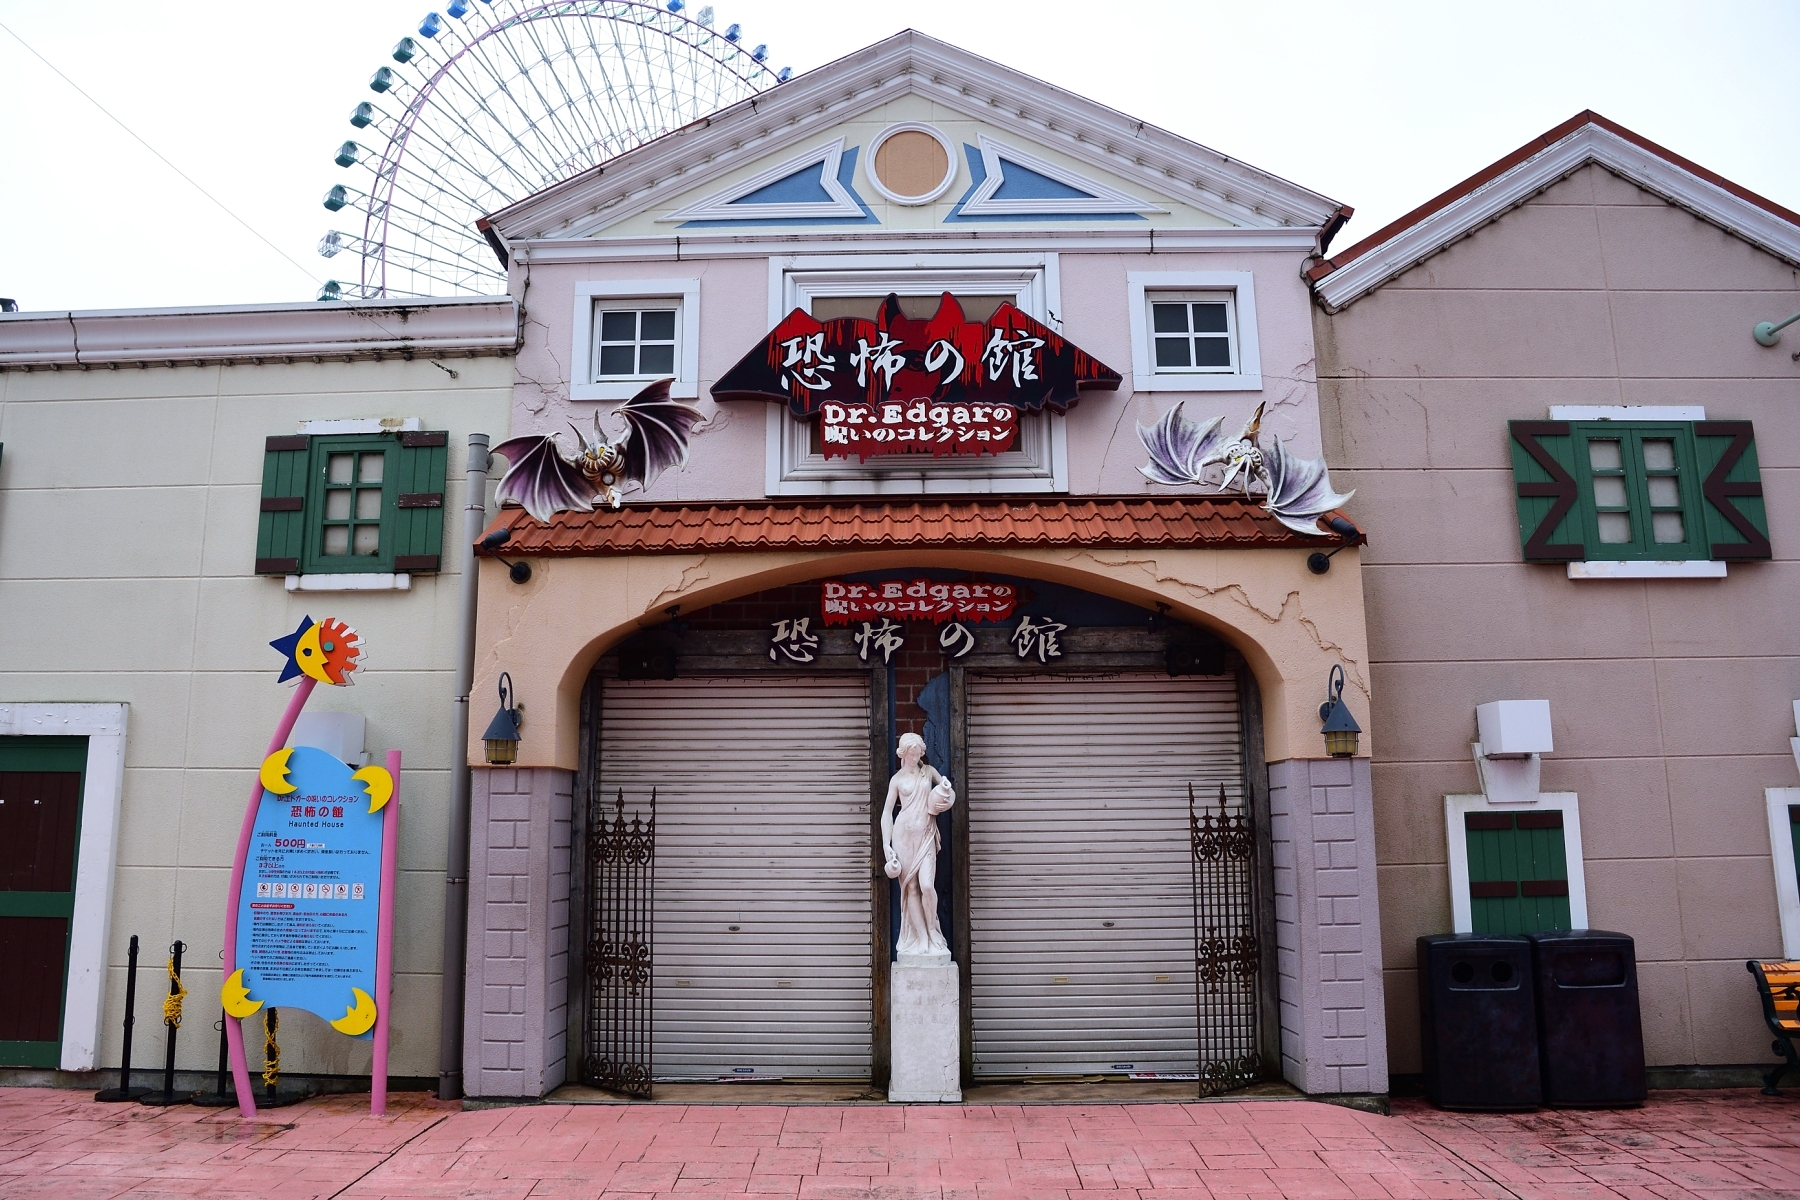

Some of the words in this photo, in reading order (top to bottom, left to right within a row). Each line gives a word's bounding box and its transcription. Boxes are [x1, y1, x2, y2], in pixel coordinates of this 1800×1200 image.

[780, 329, 1046, 391] 恐怖の館
[823, 403, 1013, 426] Dr.Edgarの
[823, 426, 1013, 444] 呪いのコレクション
[823, 582, 1013, 600] Dr.Edgarの
[823, 599, 1013, 615] 呪いのコレクション
[769, 616, 1068, 664] 恐怖の館
[291, 805, 344, 818] 恐怖の館
[289, 820, 319, 828] Haunted
[274, 838, 306, 849] 500円
